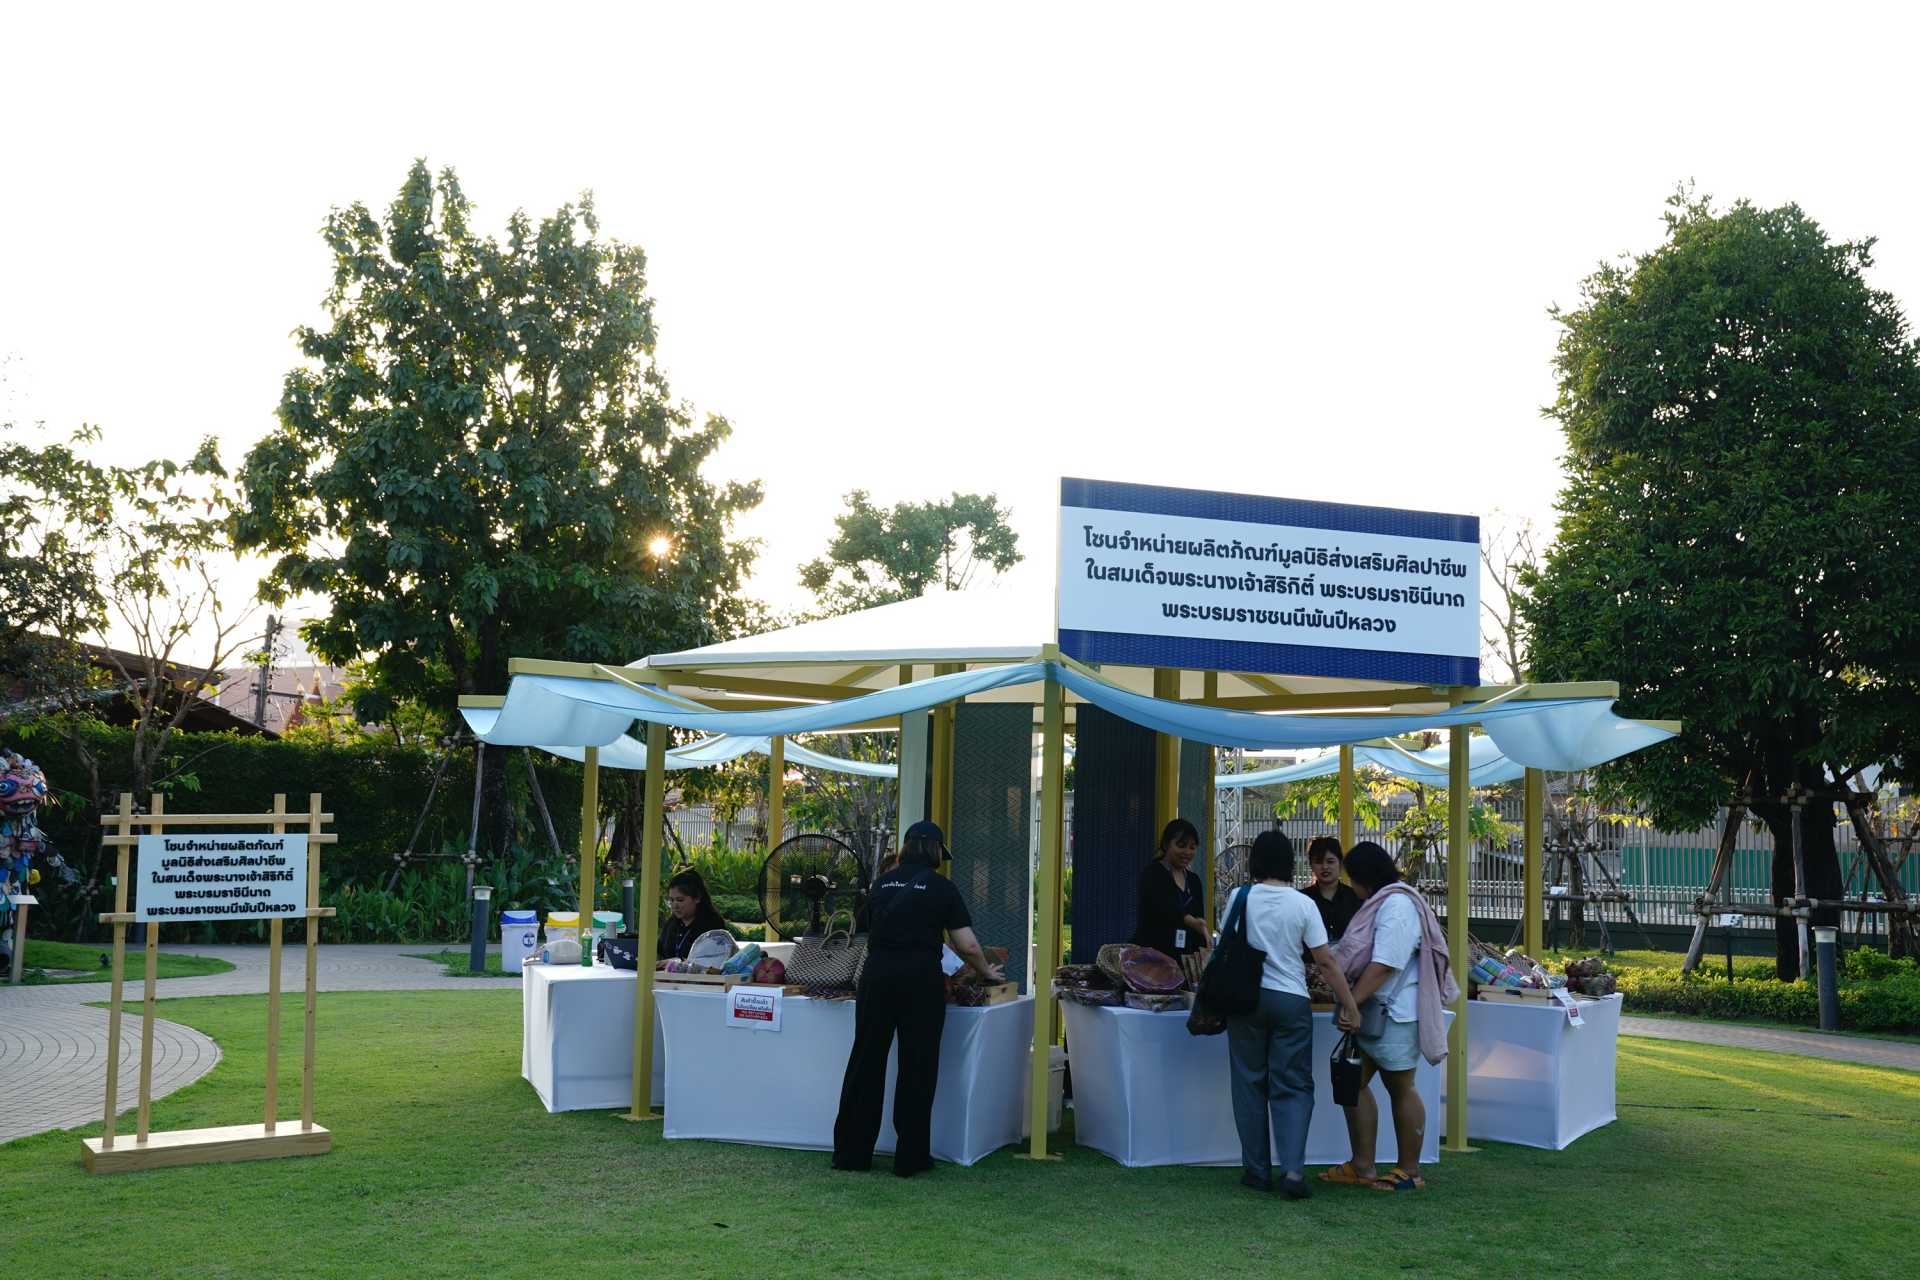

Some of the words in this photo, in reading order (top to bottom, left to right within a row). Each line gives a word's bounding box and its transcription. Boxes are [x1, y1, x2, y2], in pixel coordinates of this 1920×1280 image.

[1083, 525, 1467, 578] โซนจำหน่ายผลิตภัณฑ์มูลนิธิส่งเสริมศิลปาชีพ
[1085, 557, 1316, 597] ในสมเด็จพระนางเจ้าสิริกิติ์
[1319, 583, 1465, 608] พระบรมราชินีนาถ
[1161, 602, 1397, 633] พระบรมราชชนนีพันปีหลวง
[164, 838, 285, 851] โซนจำหน่ายผลิตภัณฑ์
[161, 855, 286, 871] มูลนิธิส่งเสริมศิลปาชีพ
[151, 867, 294, 884] ในสมเด็จพระนางเจ้าสิริกิติ์
[174, 886, 271, 899] พระบรมราชินีนาถ
[146, 902, 296, 916] พระบรมราชชนนีพันปีหลวง
